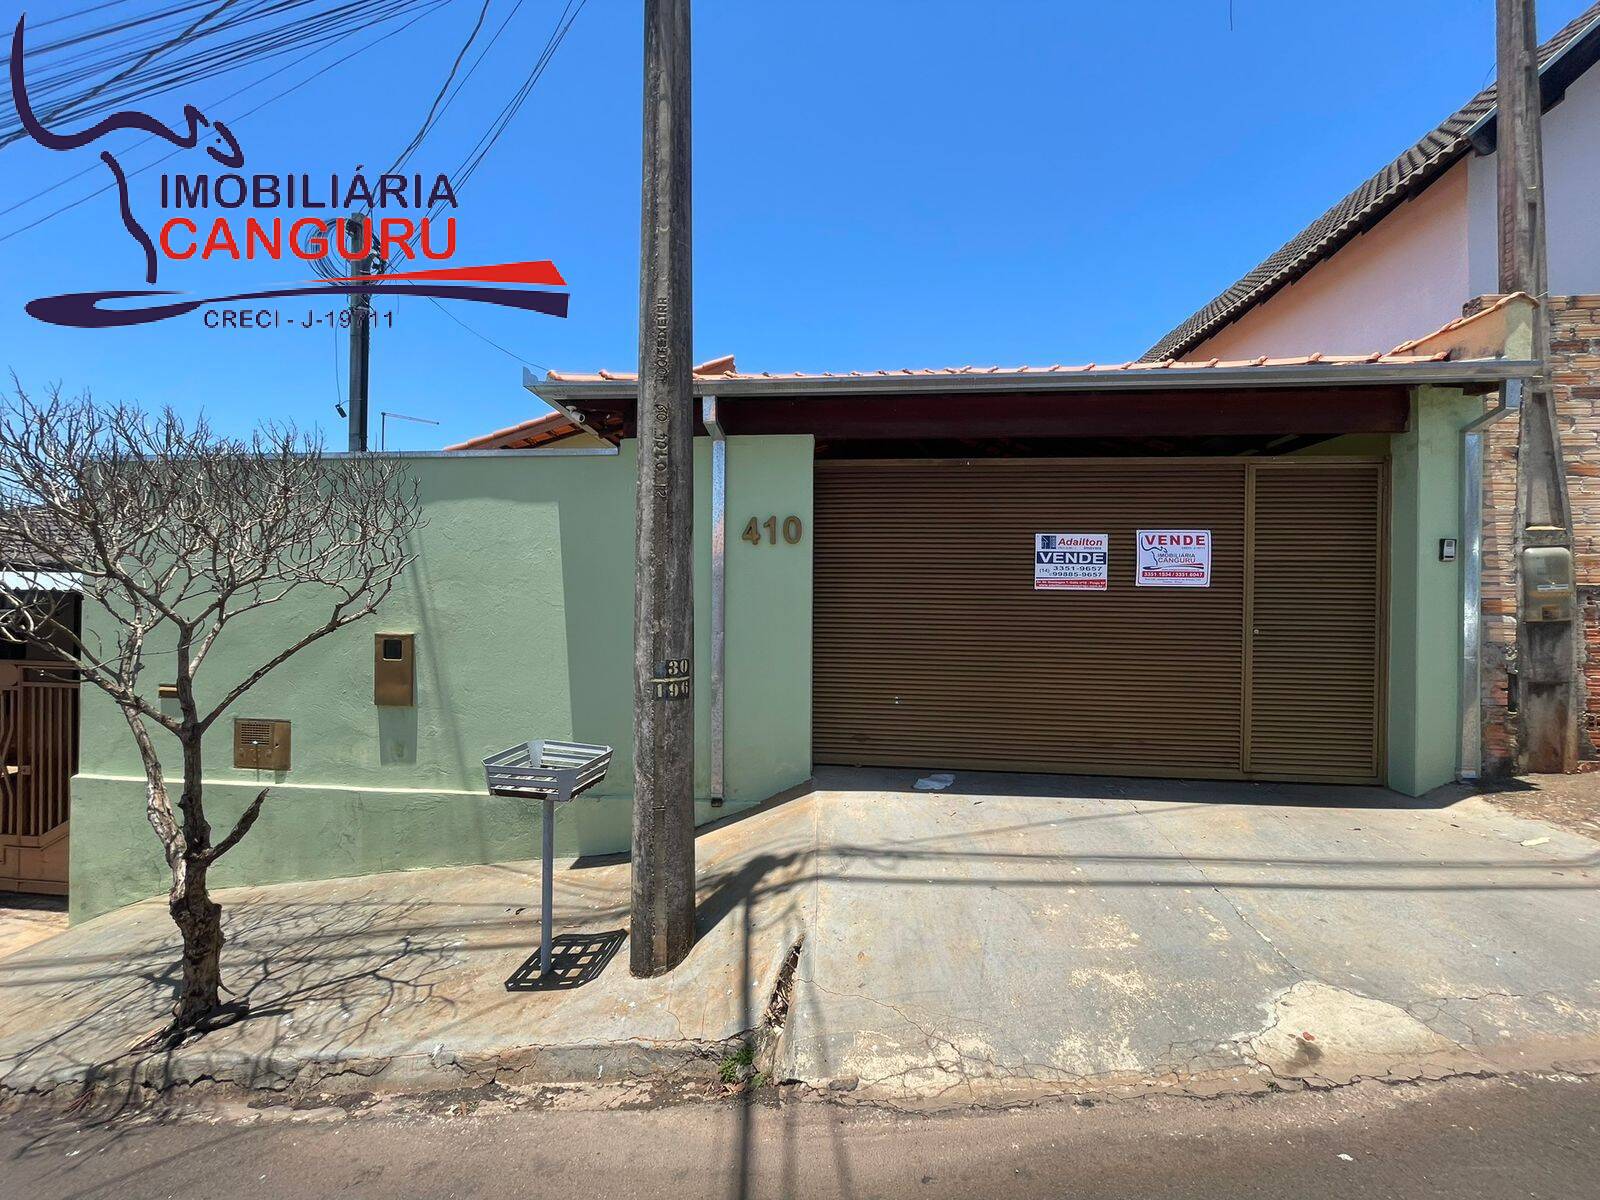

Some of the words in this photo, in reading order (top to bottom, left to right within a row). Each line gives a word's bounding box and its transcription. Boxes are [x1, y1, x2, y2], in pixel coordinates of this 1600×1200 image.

[742, 515, 803, 545] 410
[1058, 537, 1103, 546] Adailton
[1145, 534, 1206, 545] VENDE
[1039, 552, 1104, 564] VENDE
[668, 659, 688, 675] 30
[656, 681, 689, 698] 196
